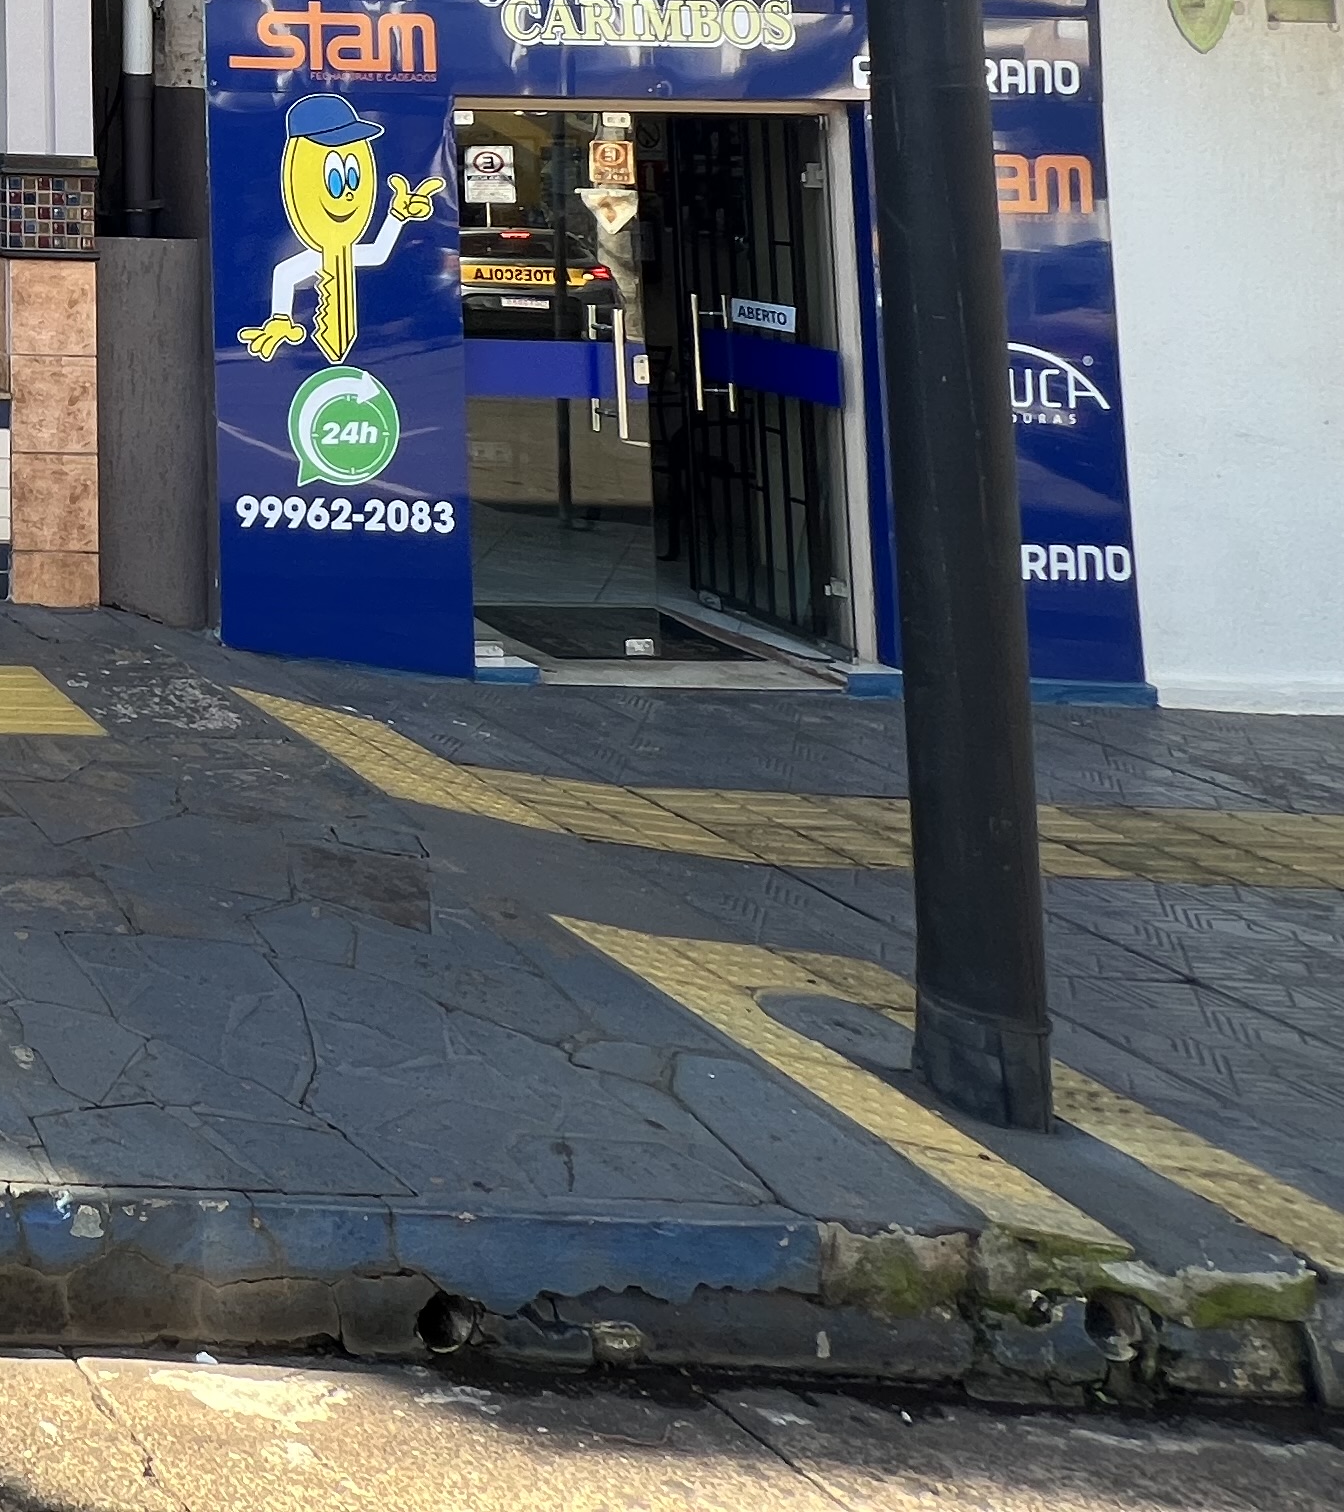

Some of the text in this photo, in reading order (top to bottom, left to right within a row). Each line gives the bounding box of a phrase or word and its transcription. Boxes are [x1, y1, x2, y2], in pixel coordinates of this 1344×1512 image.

[983, 58, 1082, 95] RANO
[993, 154, 1095, 214] am
[737, 304, 789, 327] ABERTO
[321, 421, 379, 445] 24h
[235, 494, 456, 534] 99962-2083
[1019, 544, 1133, 582] RANO
